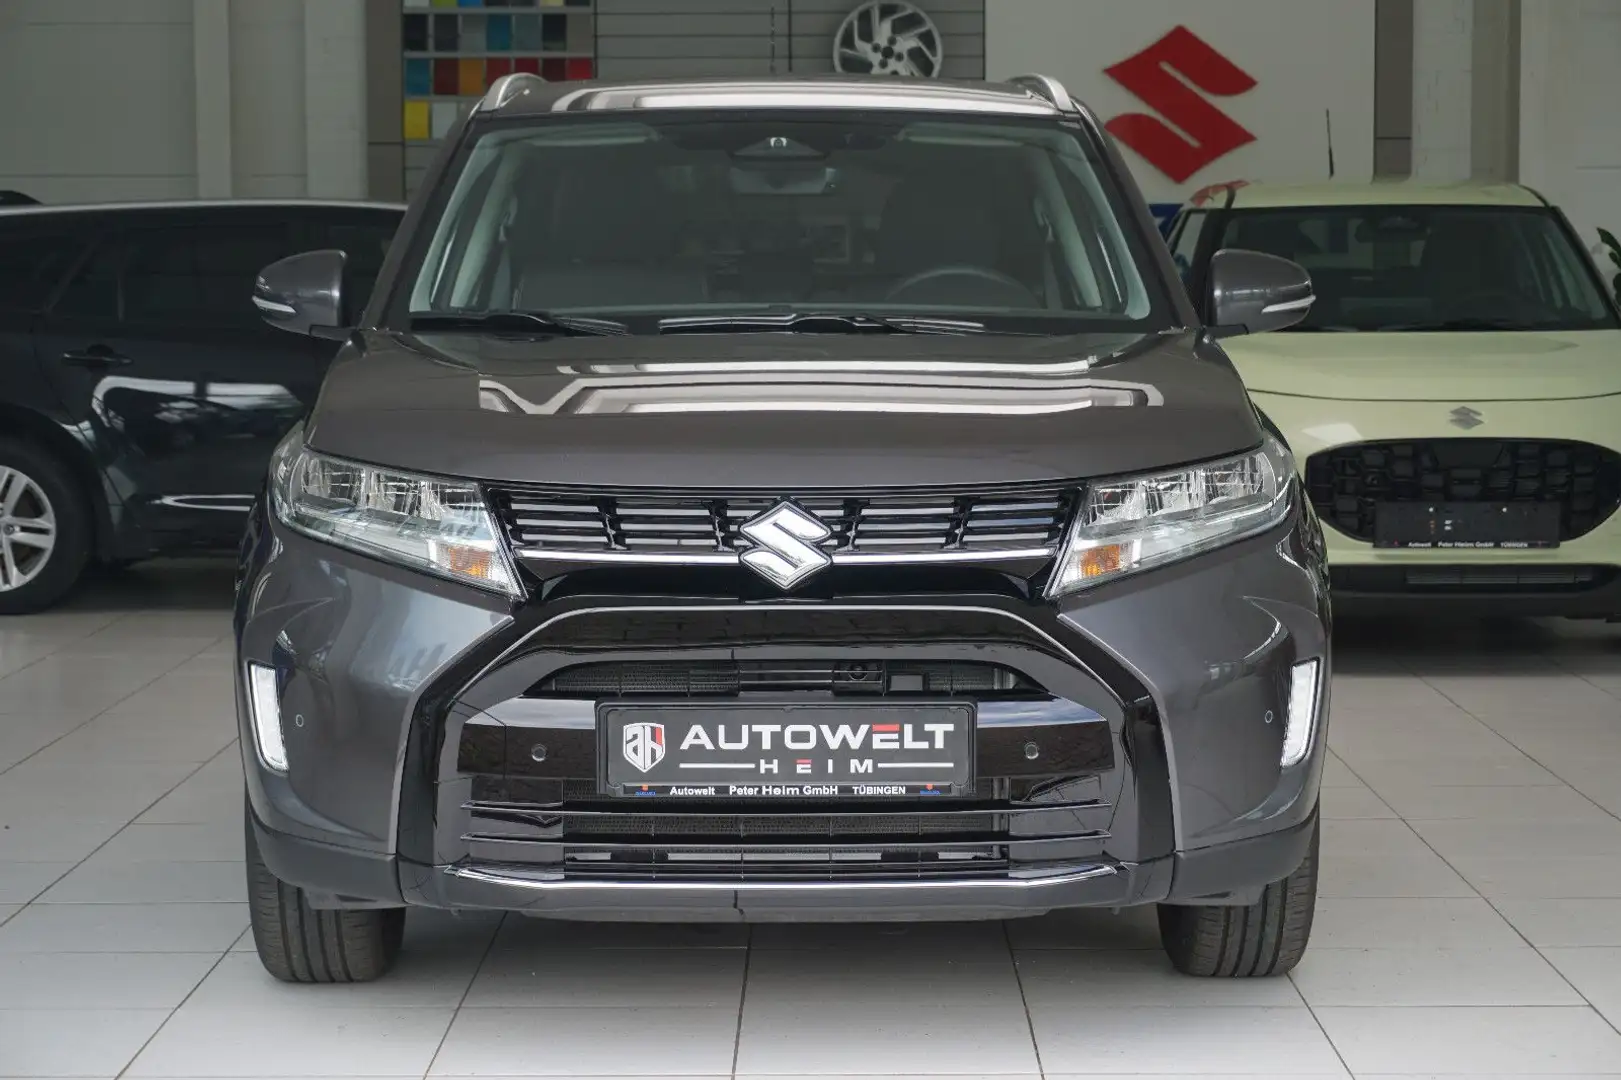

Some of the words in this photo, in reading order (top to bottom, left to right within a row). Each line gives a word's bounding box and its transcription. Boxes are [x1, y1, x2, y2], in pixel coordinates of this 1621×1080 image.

[679, 723, 955, 750] AUTOWELT
[759, 758, 874, 774] HEIM
[670, 785, 716, 796] Autowelt
[728, 785, 760, 796] Peter
[761, 785, 801, 796] Heim
[802, 785, 839, 796] GmbH
[852, 784, 907, 796] TÜBINGEN
